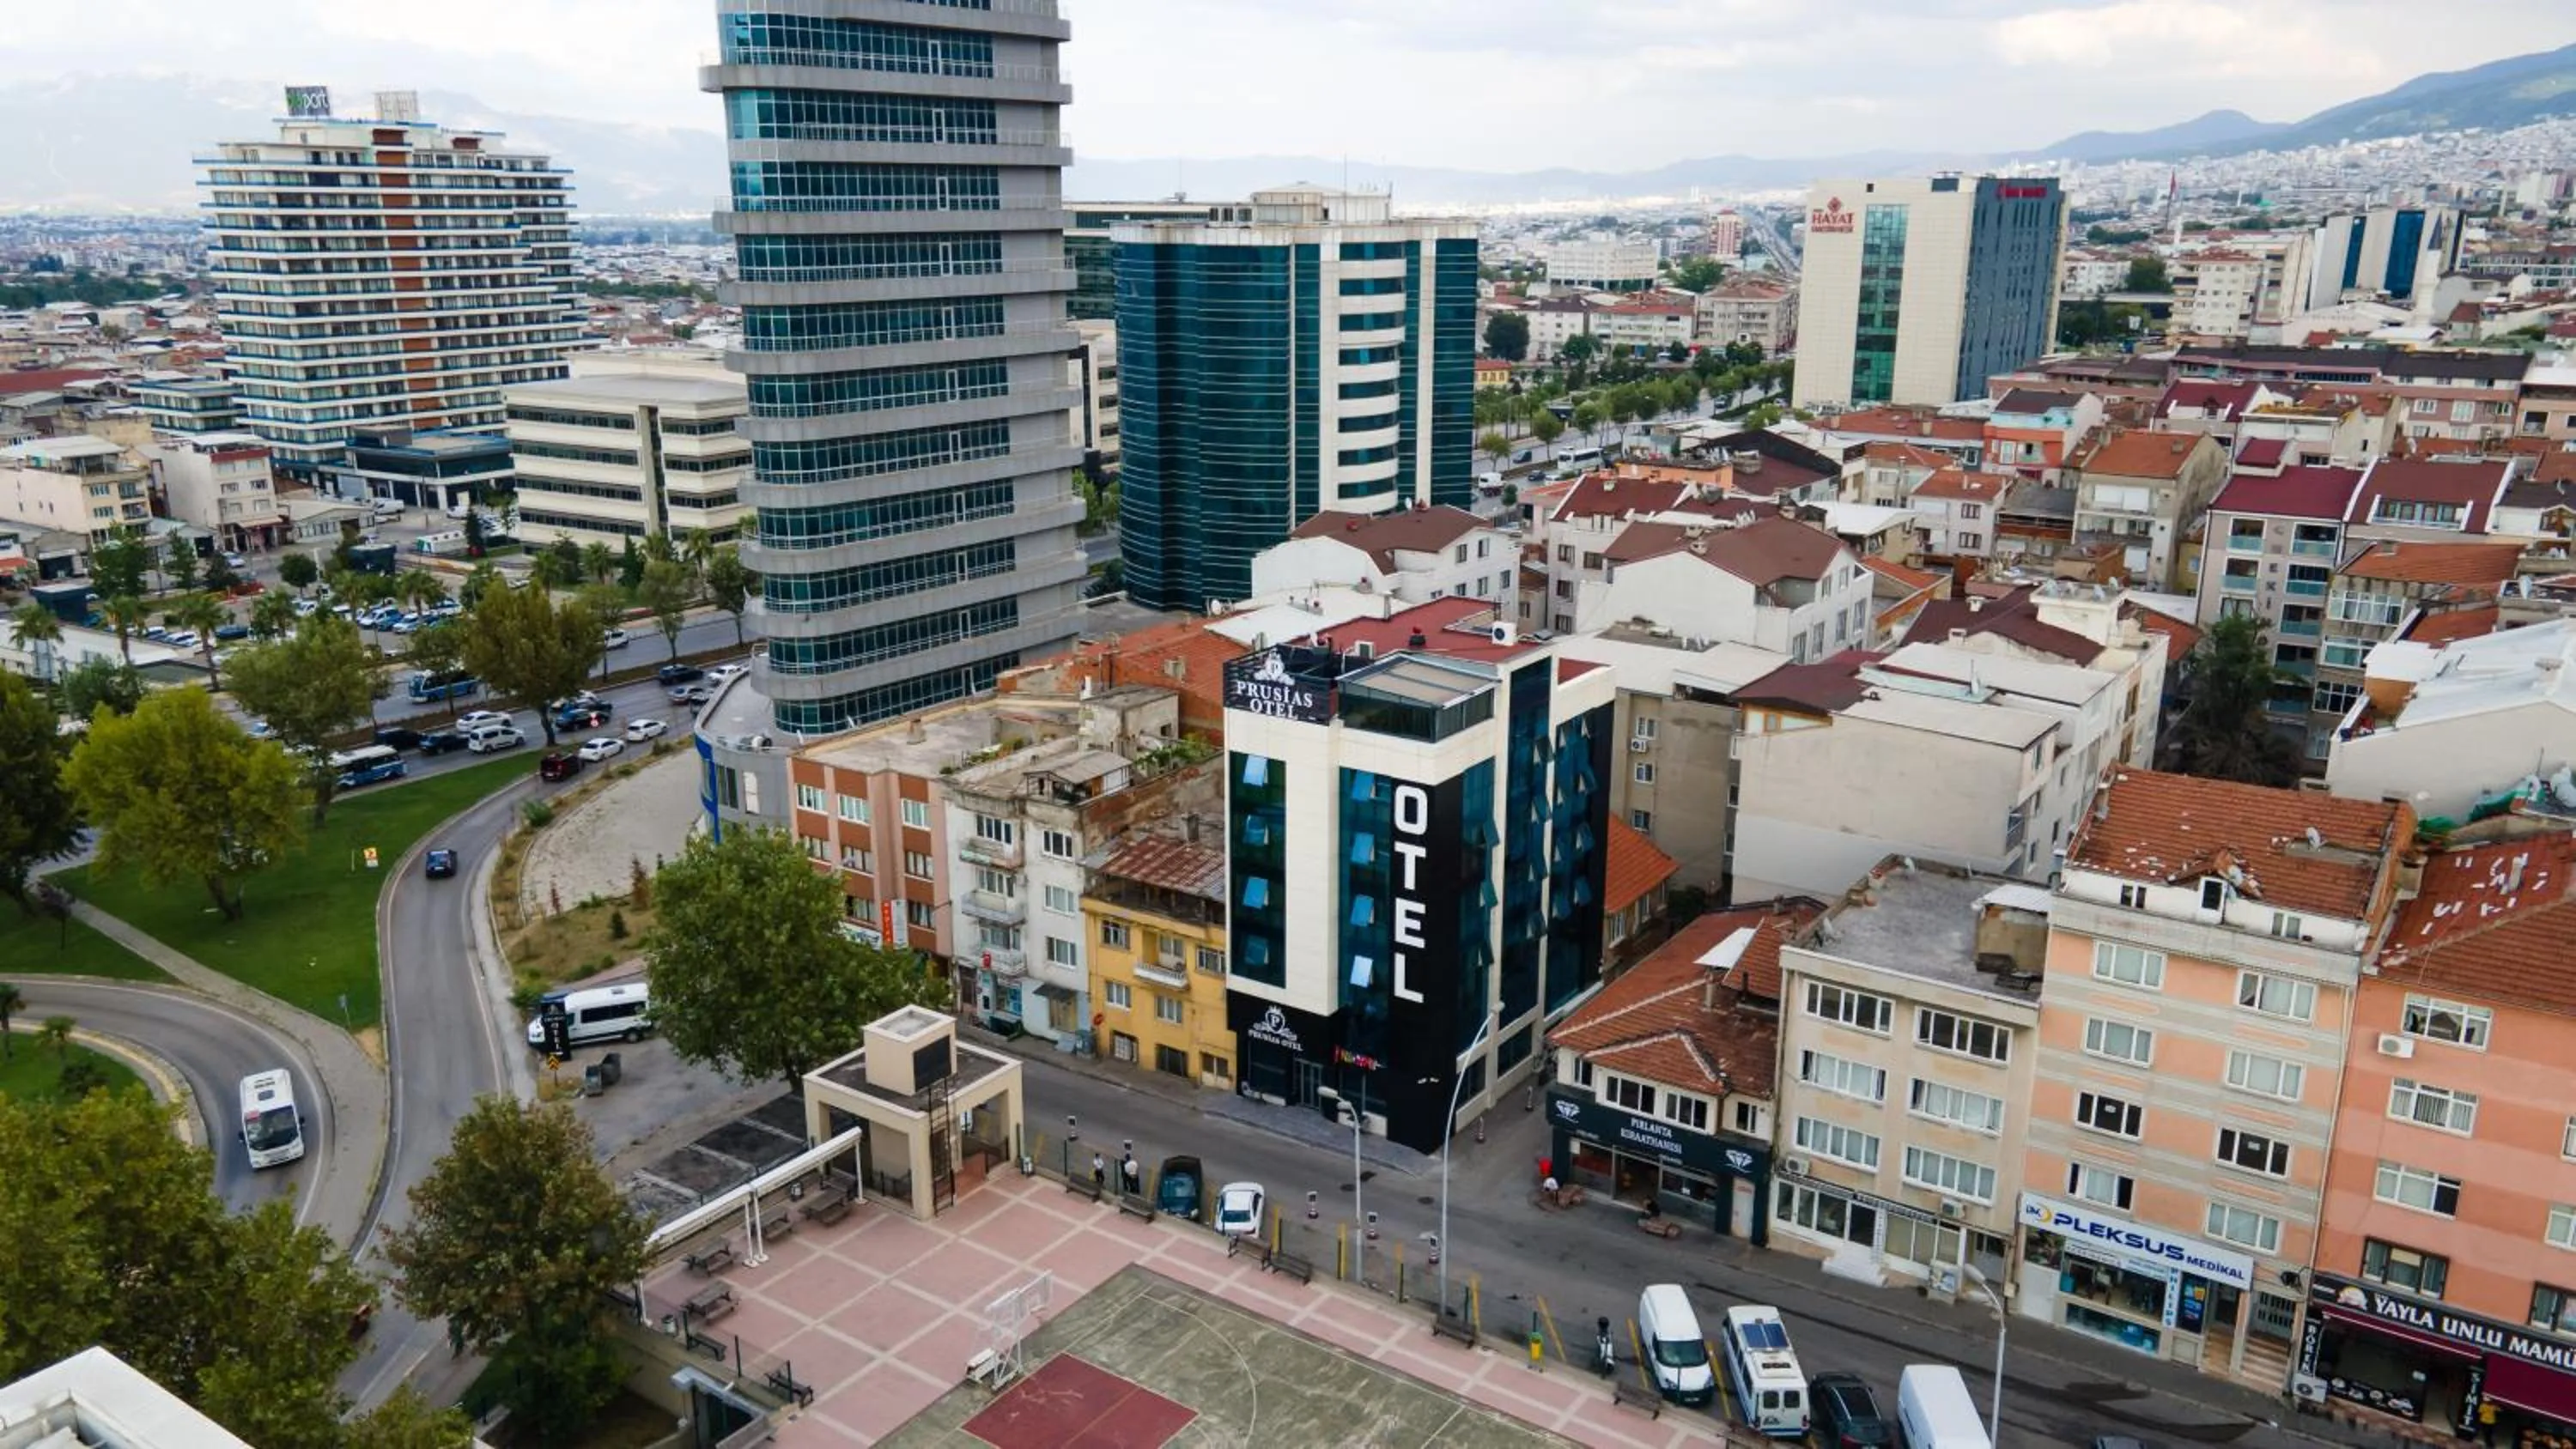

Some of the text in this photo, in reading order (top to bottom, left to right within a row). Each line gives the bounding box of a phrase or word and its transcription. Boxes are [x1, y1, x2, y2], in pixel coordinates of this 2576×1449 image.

[1813, 212, 1855, 224] HAYAT
[1236, 681, 1314, 708] PRUSİAS
[1250, 698, 1299, 720] OTEL
[1394, 785, 1428, 1003] OTEL
[2053, 1212, 2185, 1262] PLEKSUS
[2187, 1256, 2245, 1281] MEDİKAL
[2374, 1294, 2435, 1329] YAYLA
[2442, 1316, 2503, 1348] UNLU
